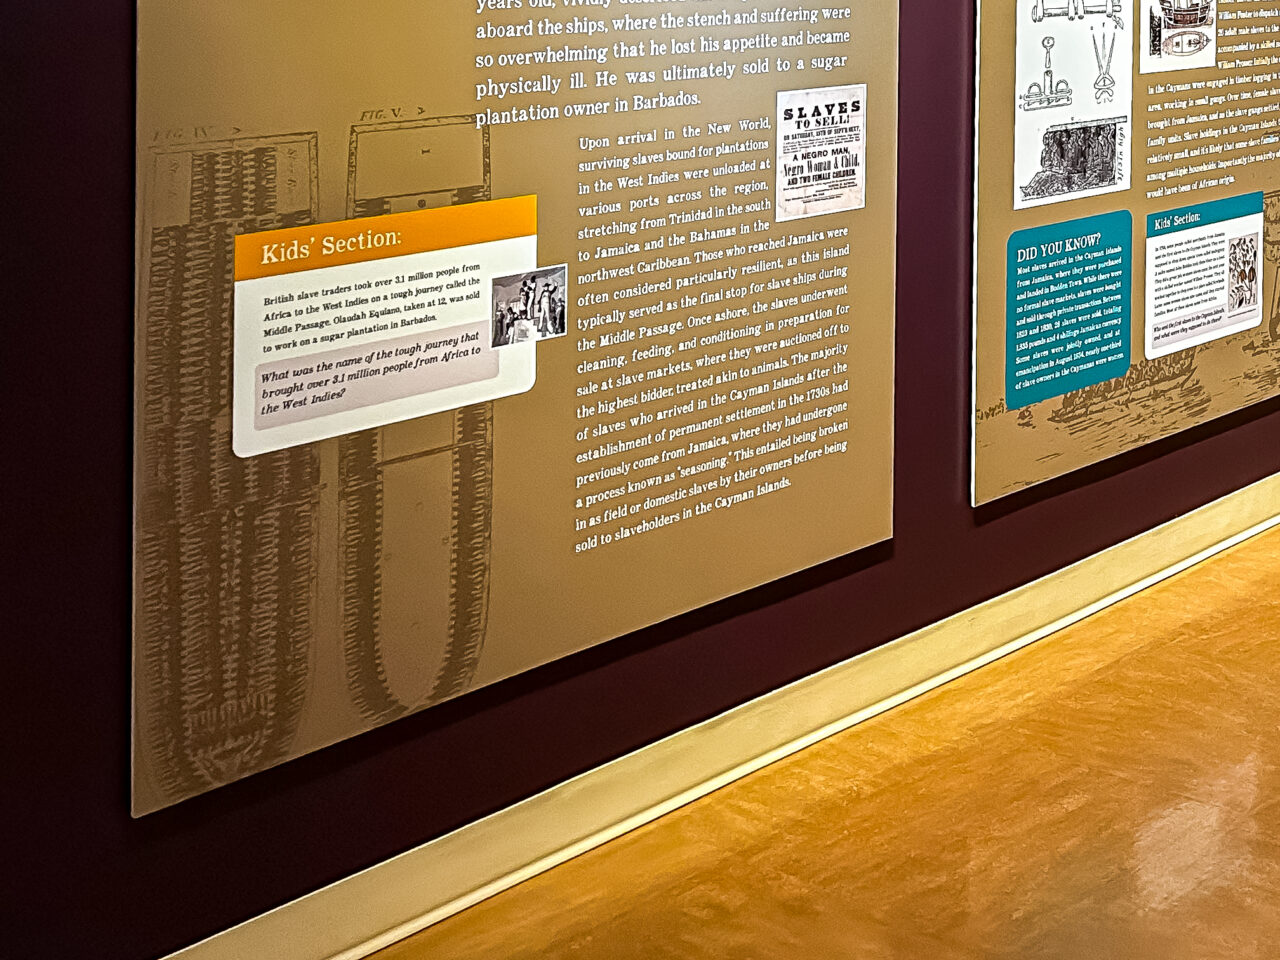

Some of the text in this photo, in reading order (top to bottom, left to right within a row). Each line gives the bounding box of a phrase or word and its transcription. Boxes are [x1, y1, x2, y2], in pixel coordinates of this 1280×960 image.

[475, 91, 701, 129] plantation owner in Barbados.
[784, 100, 860, 121] SLAVES
[795, 114, 850, 130] TO SELL!
[580, 117, 771, 150] Upon arrival in the New World,
[783, 163, 804, 177] Negro
[807, 160, 831, 174] Woman
[793, 153, 799, 161] A
[801, 150, 828, 160] NEGRO
[1173, 212, 1200, 226] Section:
[322, 230, 401, 255] Section:
[1017, 232, 1101, 262] DID YOU KNOW?
[1017, 266, 1030, 275] Most
[1048, 257, 1067, 267] arrived
[1075, 254, 1083, 262] the
[1084, 251, 1104, 260] Cayman
[1106, 246, 1122, 255] Islands
[264, 264, 480, 306] British slave traders took over 3.1 million people from
[261, 388, 346, 415] the West Indies?
[576, 477, 791, 552] sold to slaveholders in the Cayman Islands.
